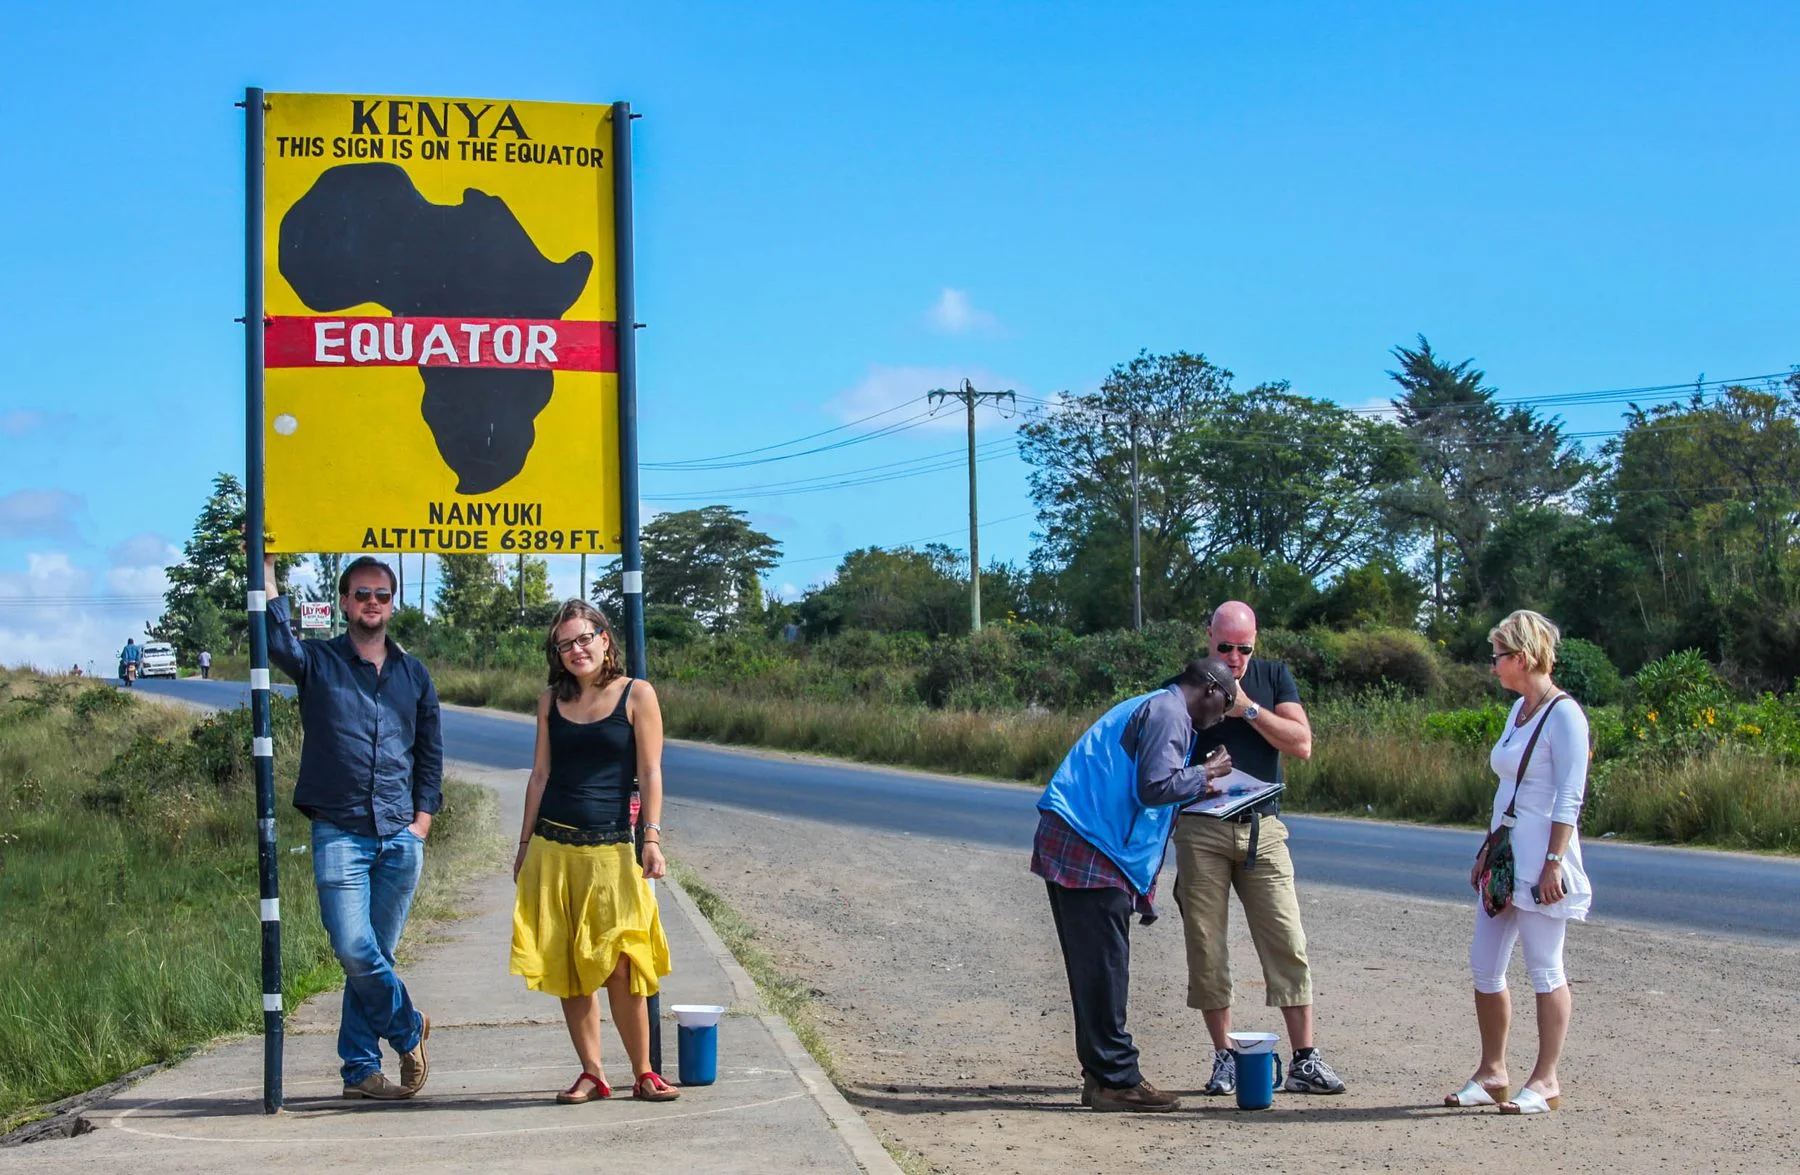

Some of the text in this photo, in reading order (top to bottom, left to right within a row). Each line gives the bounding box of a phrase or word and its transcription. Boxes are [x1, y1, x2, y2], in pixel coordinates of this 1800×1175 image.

[350, 99, 532, 140] KENYA
[276, 136, 604, 168] THIS SIGN IS ON THE EQUATOR
[314, 321, 558, 365] EQUATOR
[429, 502, 542, 526] NANYUKI
[361, 527, 604, 551] ALTITUDE 6389 FT.
